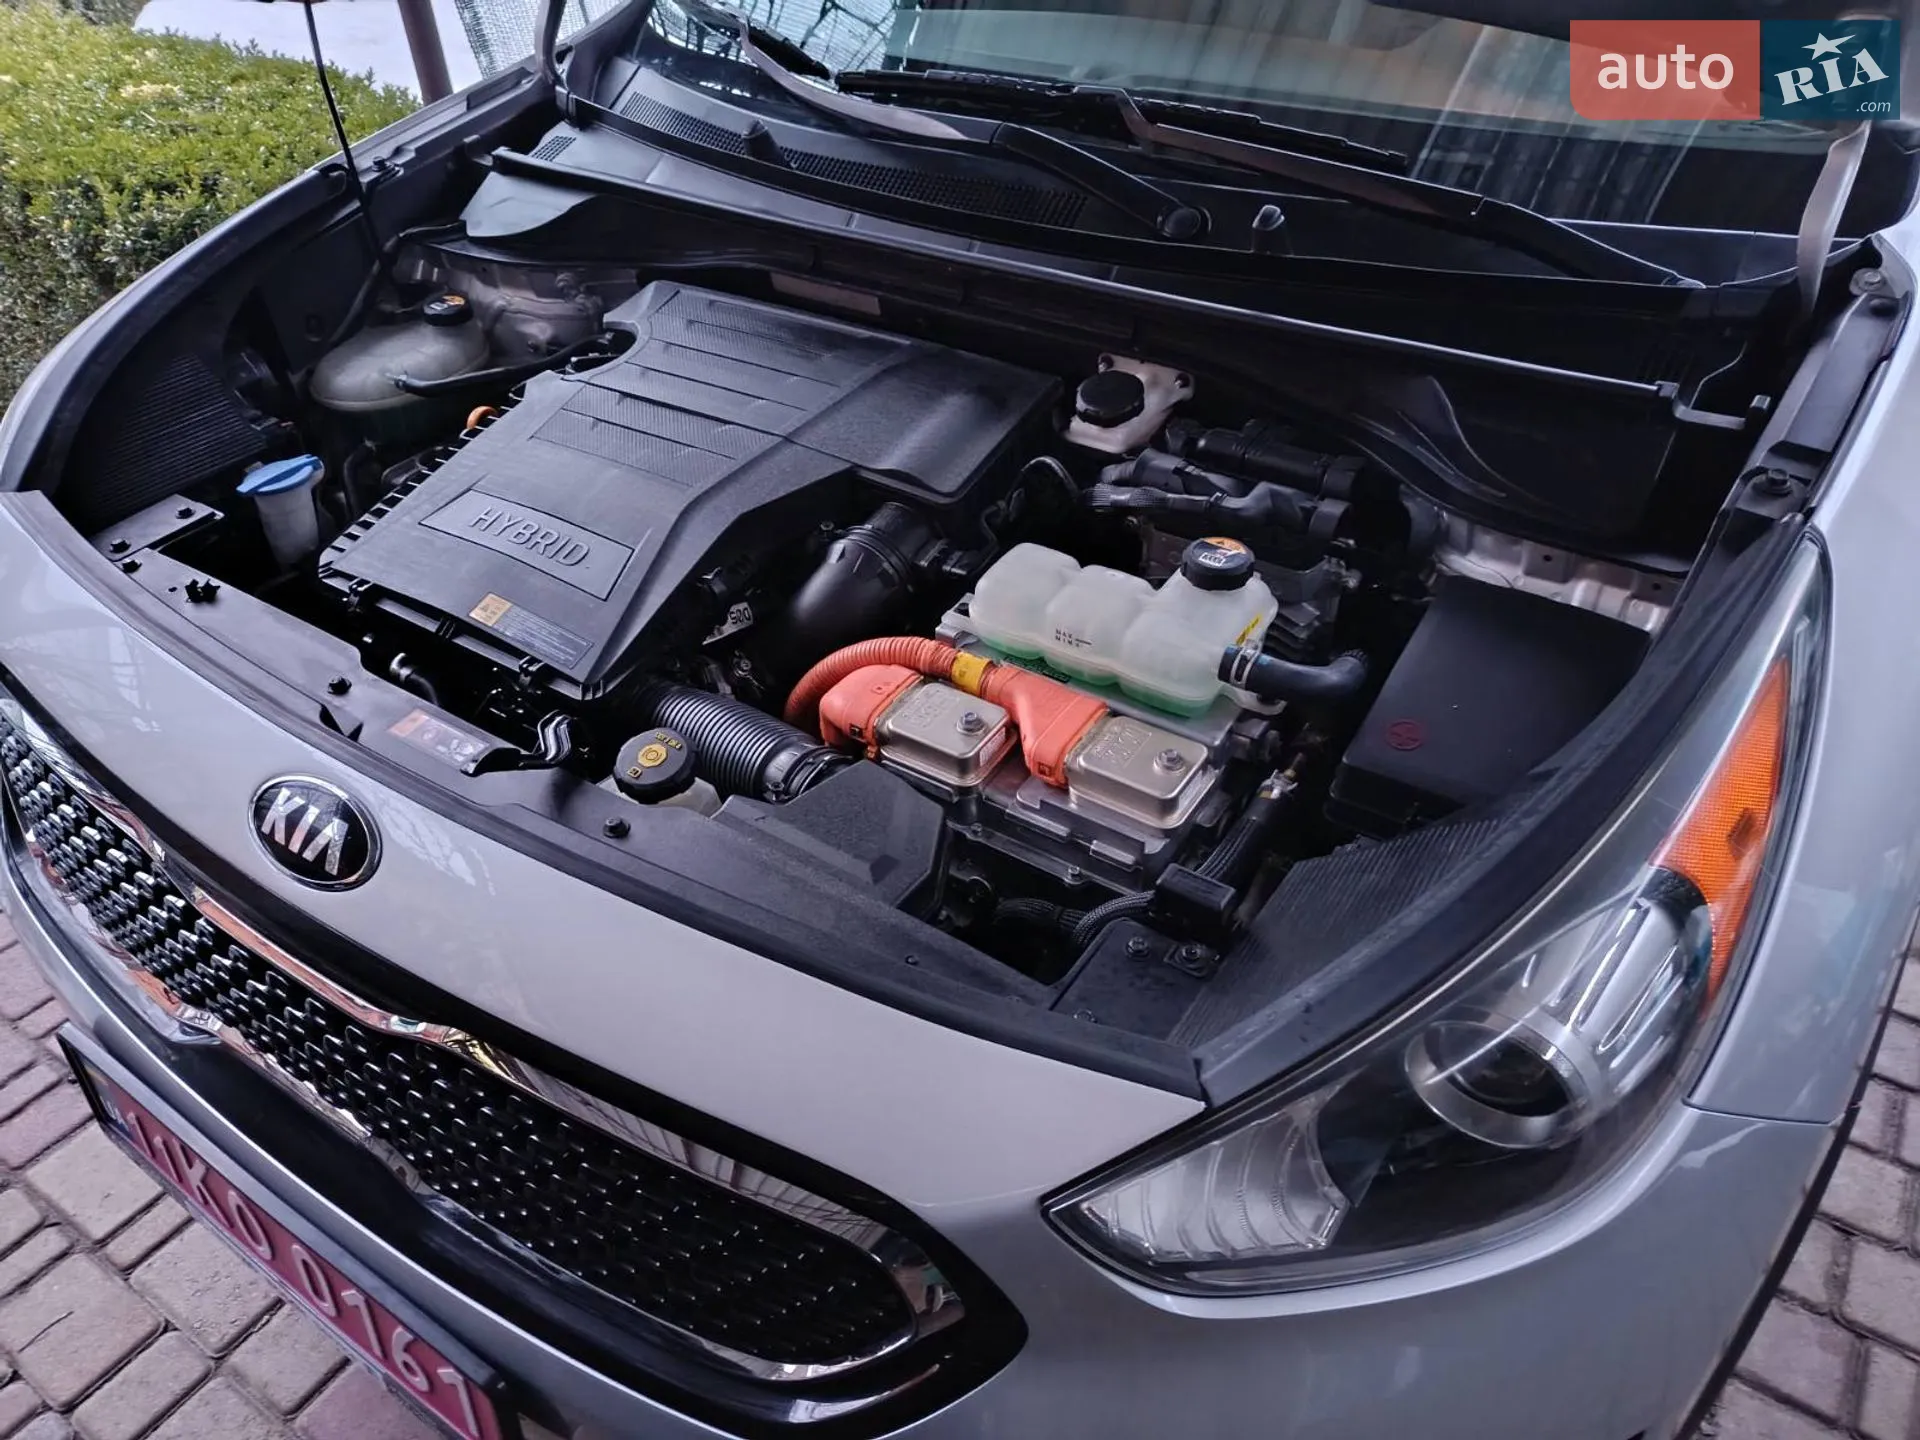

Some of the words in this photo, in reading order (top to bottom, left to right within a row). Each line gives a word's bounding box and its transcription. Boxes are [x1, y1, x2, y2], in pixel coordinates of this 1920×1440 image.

[468, 507, 591, 567] HYBRID
[261, 787, 349, 876] KIA
[291, 1244, 480, 1438] 0161
